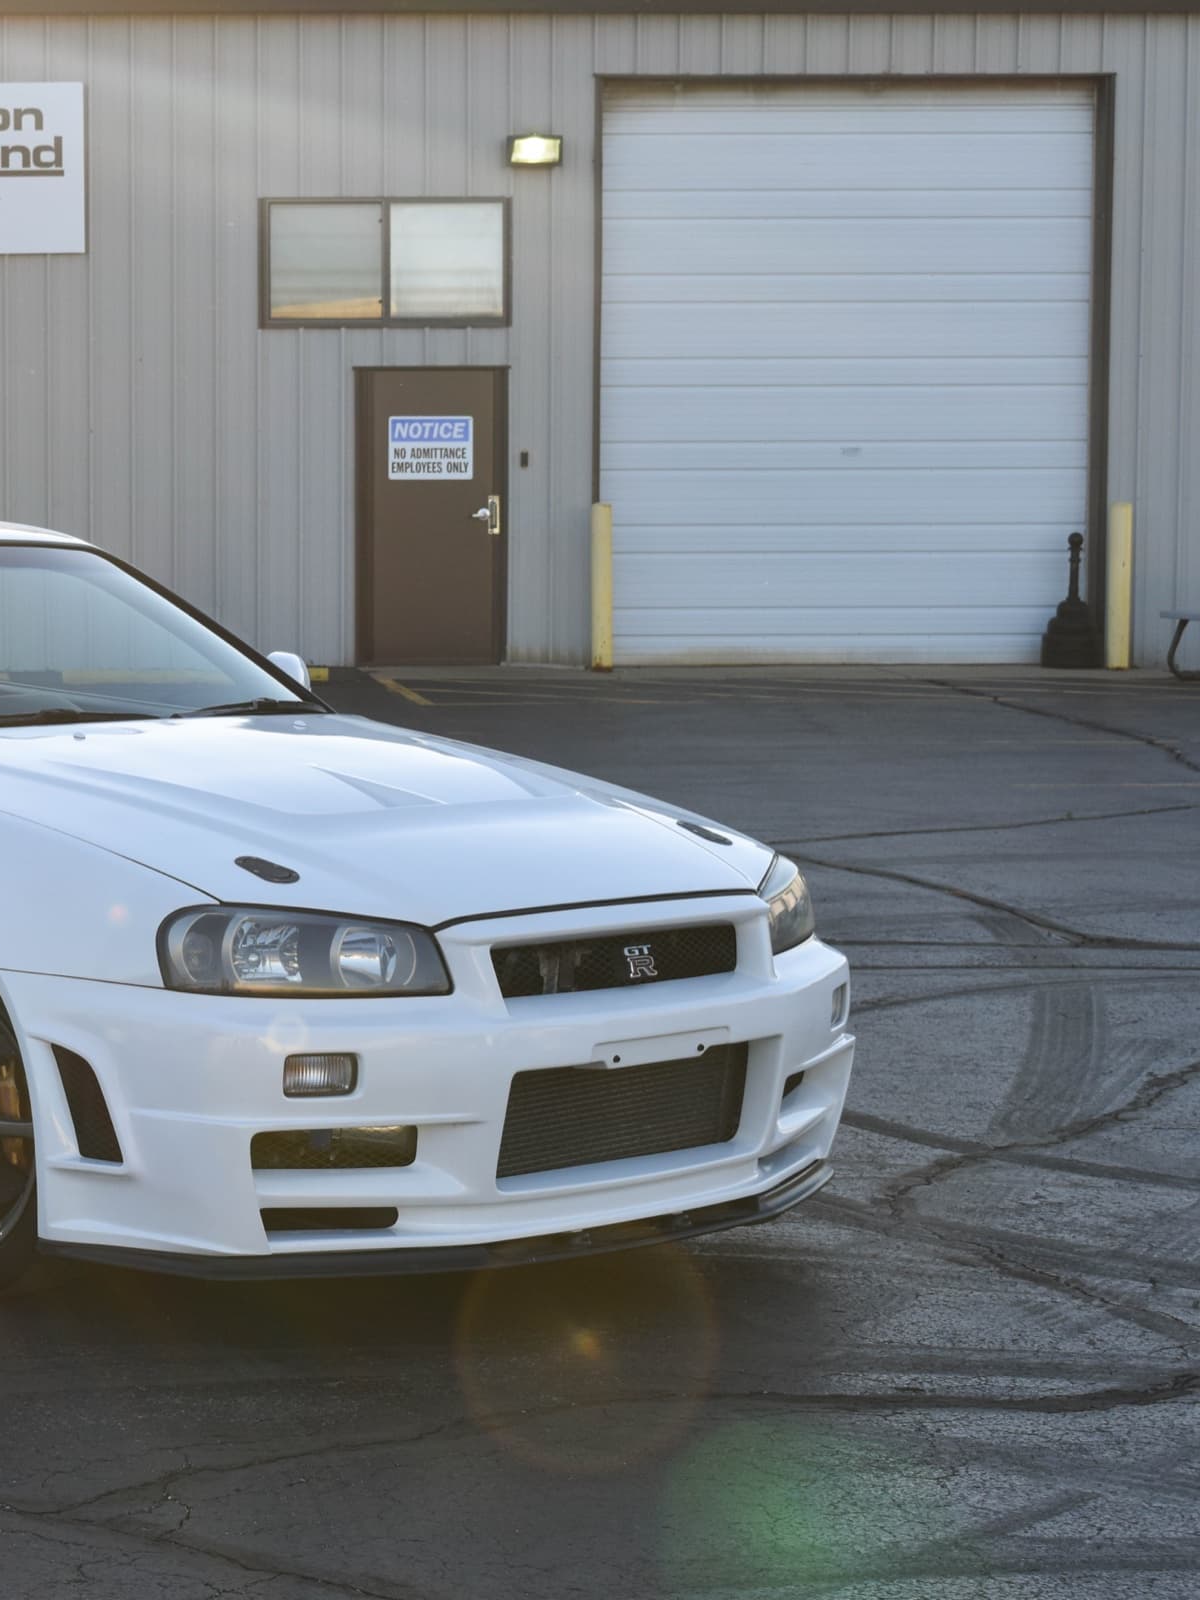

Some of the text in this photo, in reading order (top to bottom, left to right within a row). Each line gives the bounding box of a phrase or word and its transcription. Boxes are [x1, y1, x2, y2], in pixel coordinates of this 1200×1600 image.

[394, 422, 466, 439] NOTICE
[394, 448, 467, 459] NO ADMITTANCE
[391, 462, 469, 473] EMPLOYEES ONLY
[623, 944, 651, 956] GT
[627, 955, 658, 978] R
